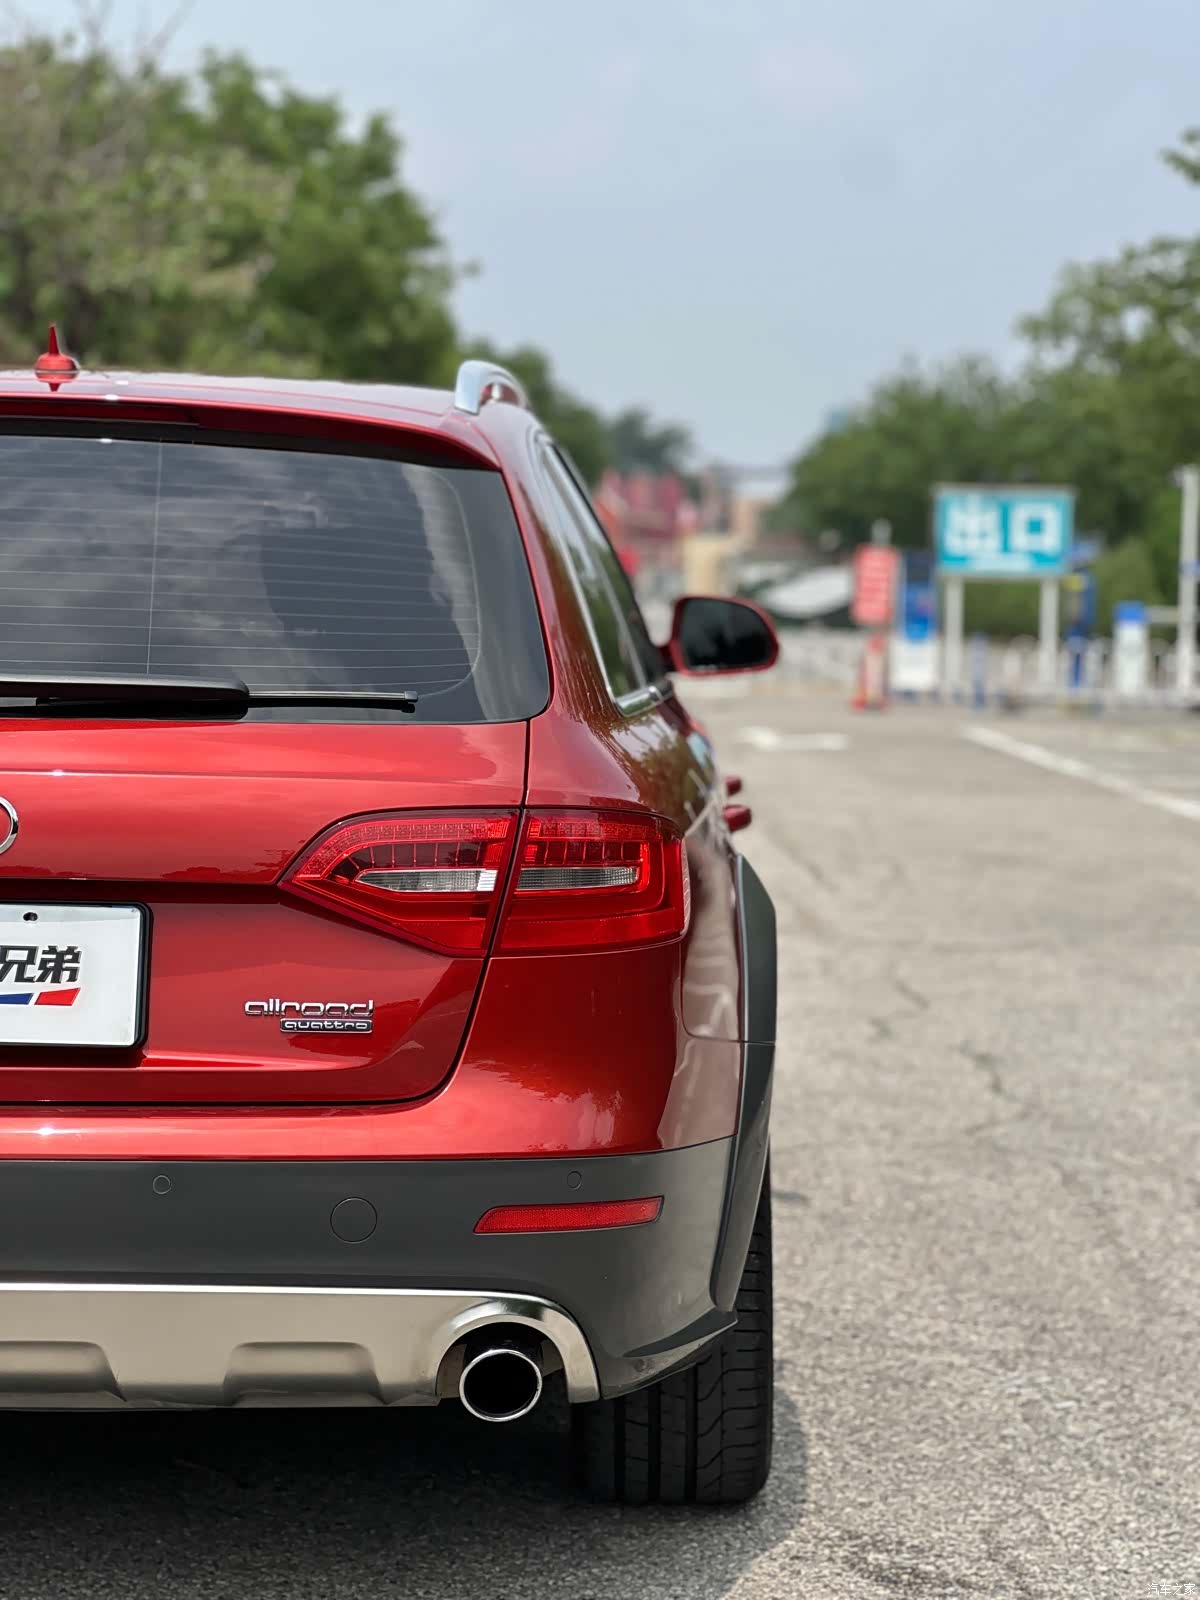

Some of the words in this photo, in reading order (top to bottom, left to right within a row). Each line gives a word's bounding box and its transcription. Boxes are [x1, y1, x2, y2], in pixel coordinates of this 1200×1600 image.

[945, 495, 1061, 554] 出口
[0, 945, 82, 984] 兄弟
[244, 998, 375, 1017] allroad
[284, 1020, 368, 1031] quattro
